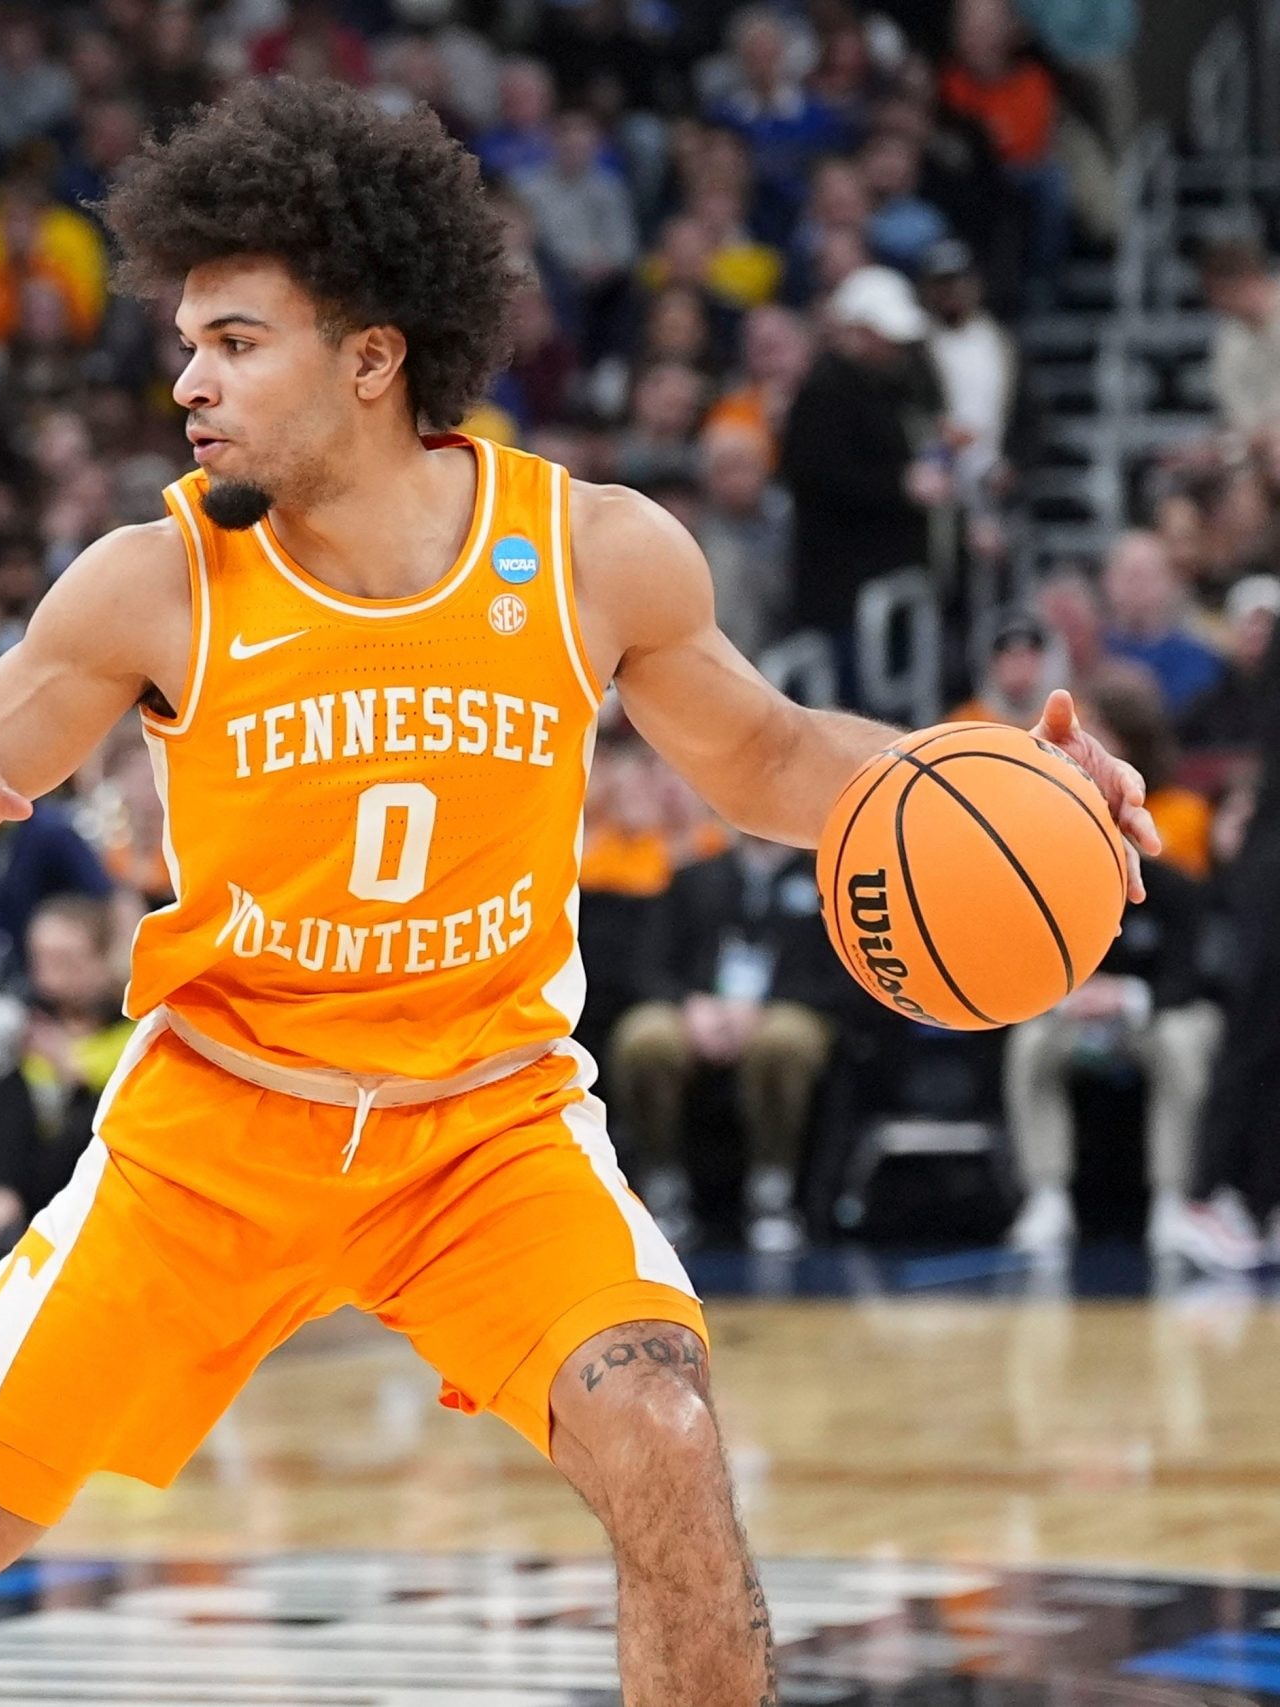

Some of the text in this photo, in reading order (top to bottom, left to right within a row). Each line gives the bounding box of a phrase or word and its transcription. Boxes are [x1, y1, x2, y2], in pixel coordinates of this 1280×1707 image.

[499, 558, 537, 572] NCAA
[491, 596, 524, 633] SEC
[226, 686, 560, 779] TENNESSEE
[347, 781, 438, 903] 0
[215, 871, 534, 974] VOLUNTEERS
